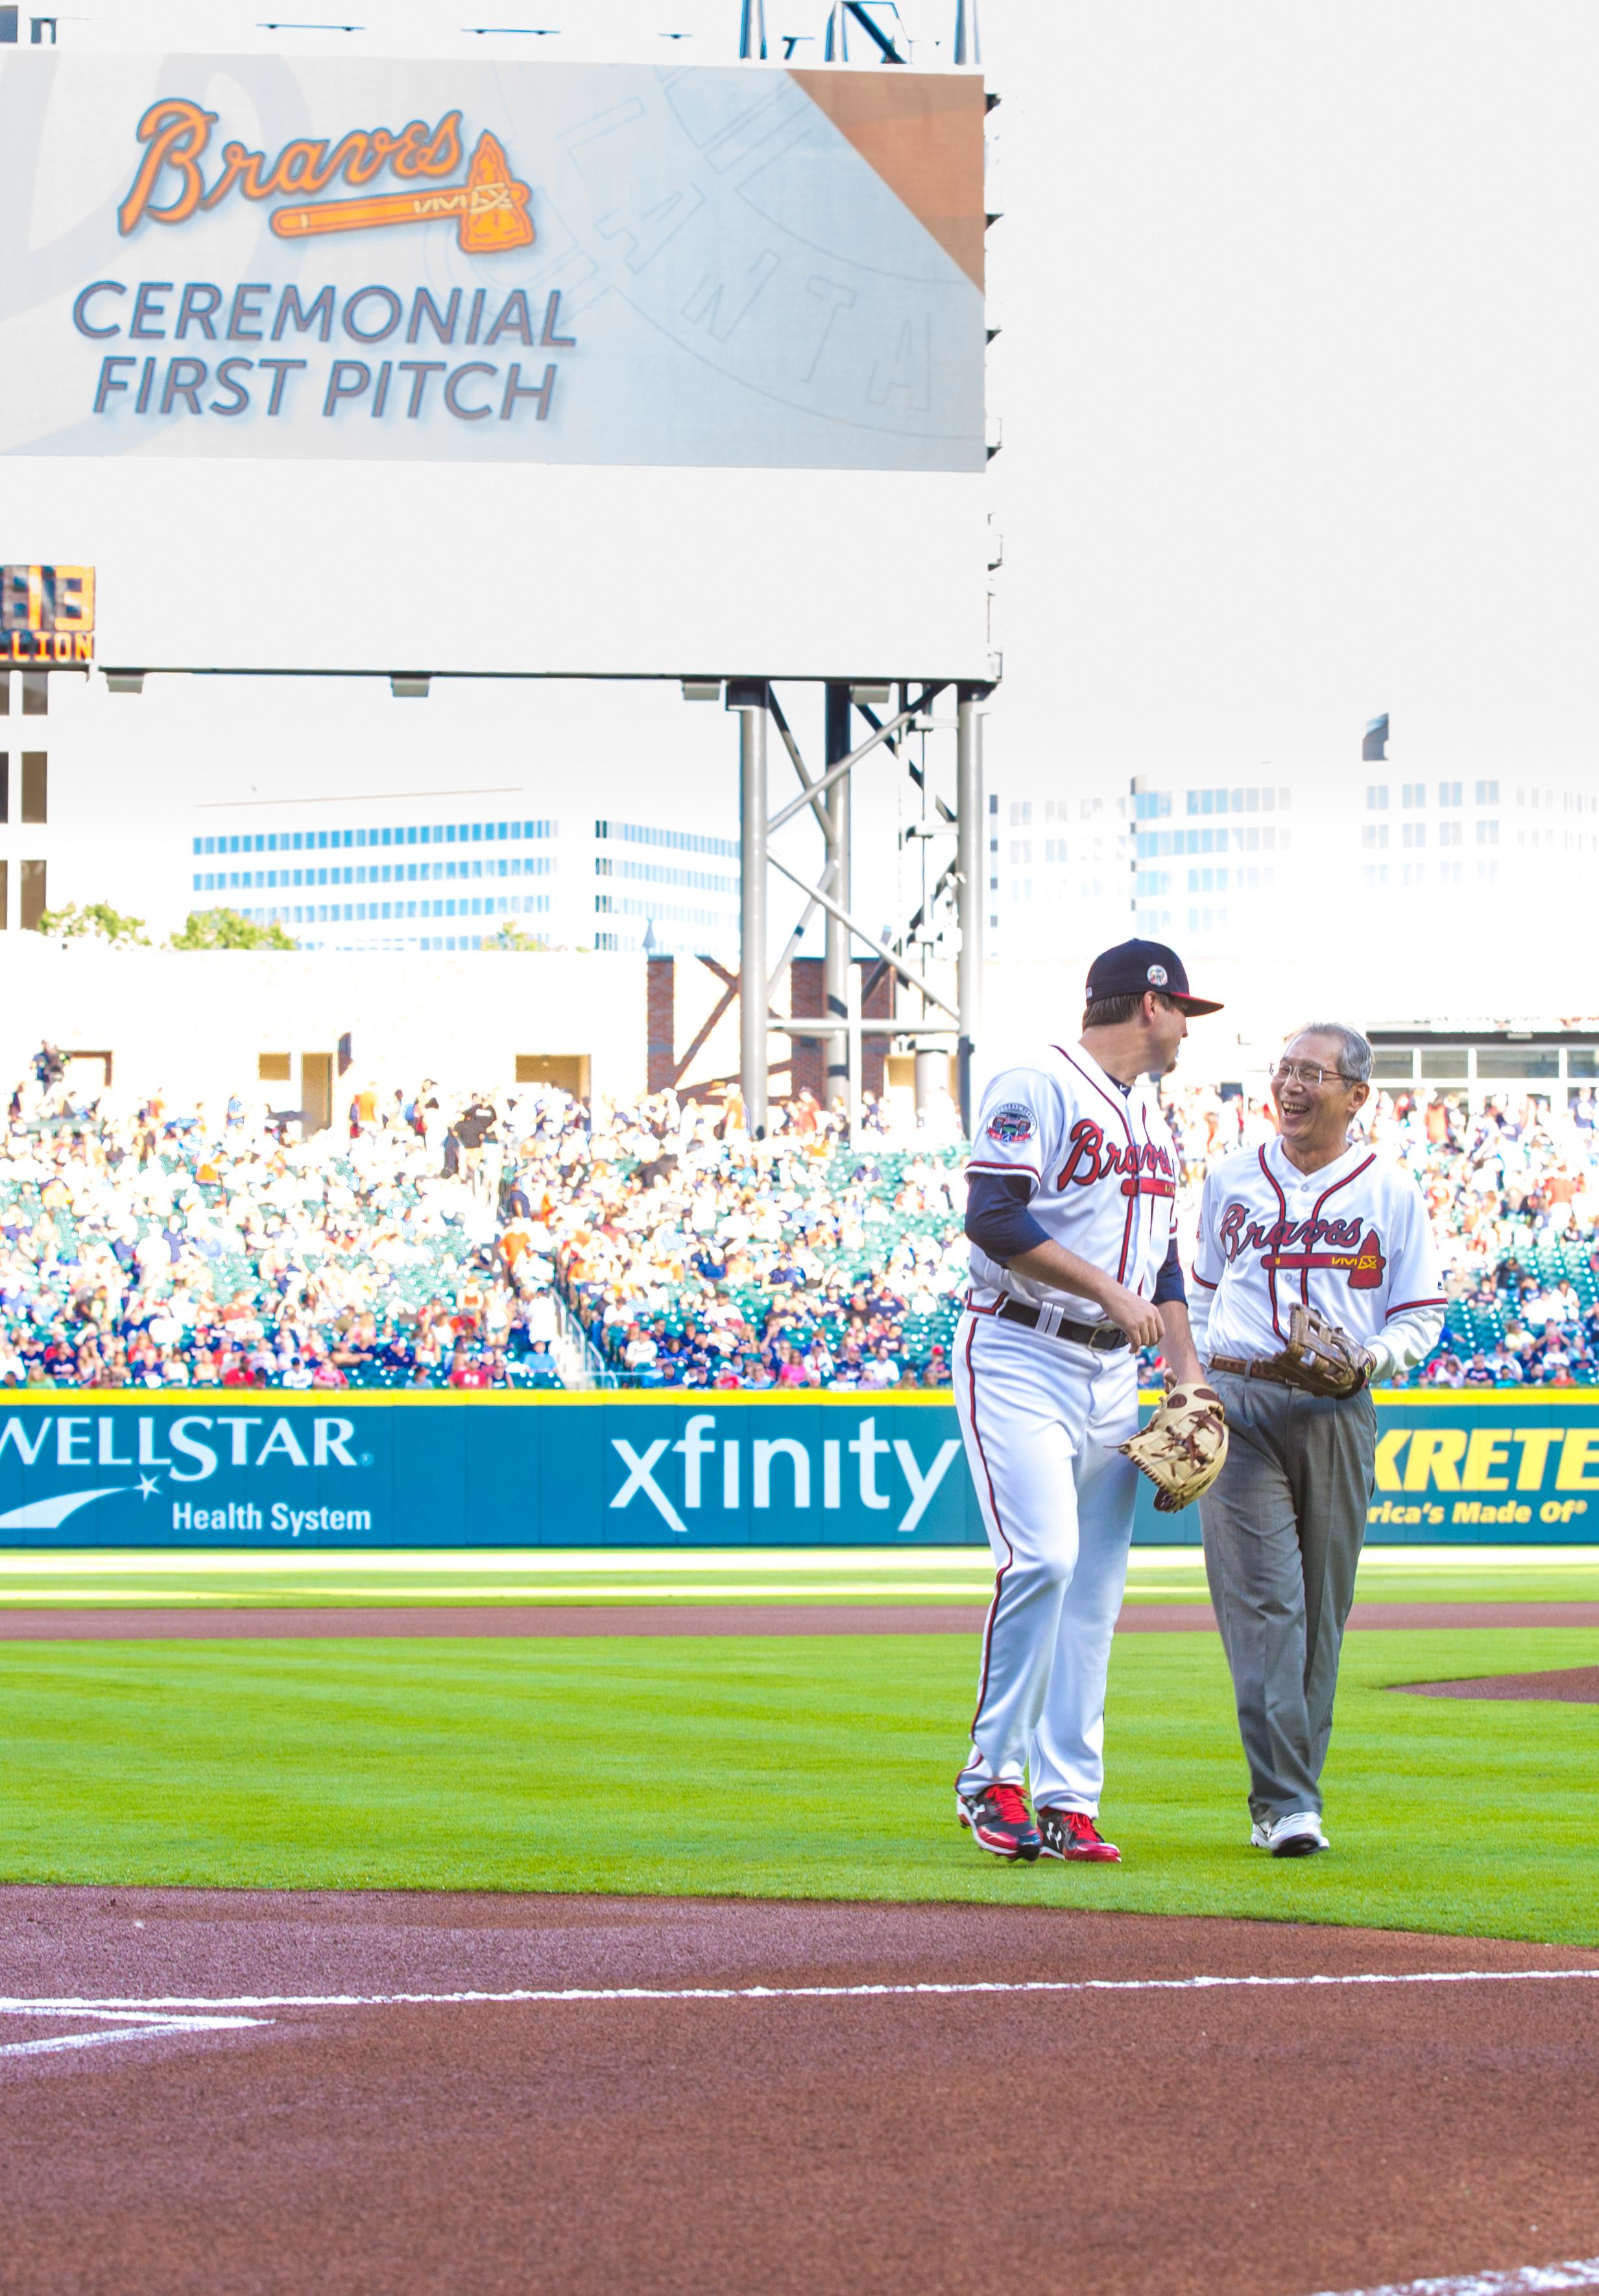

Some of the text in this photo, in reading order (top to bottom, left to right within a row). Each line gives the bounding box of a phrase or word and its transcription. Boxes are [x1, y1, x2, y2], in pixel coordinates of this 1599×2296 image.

[117, 97, 463, 237] Braves
[73, 281, 577, 348] CEREMONIAL
[93, 356, 558, 421] FIRST PITCH
[0, 631, 93, 663] LION
[1220, 1203, 1364, 1263] Braves
[608, 1415, 962, 1532] xfinity
[173, 1502, 372, 1537] Health System
[1452, 1500, 1532, 1524] Made
